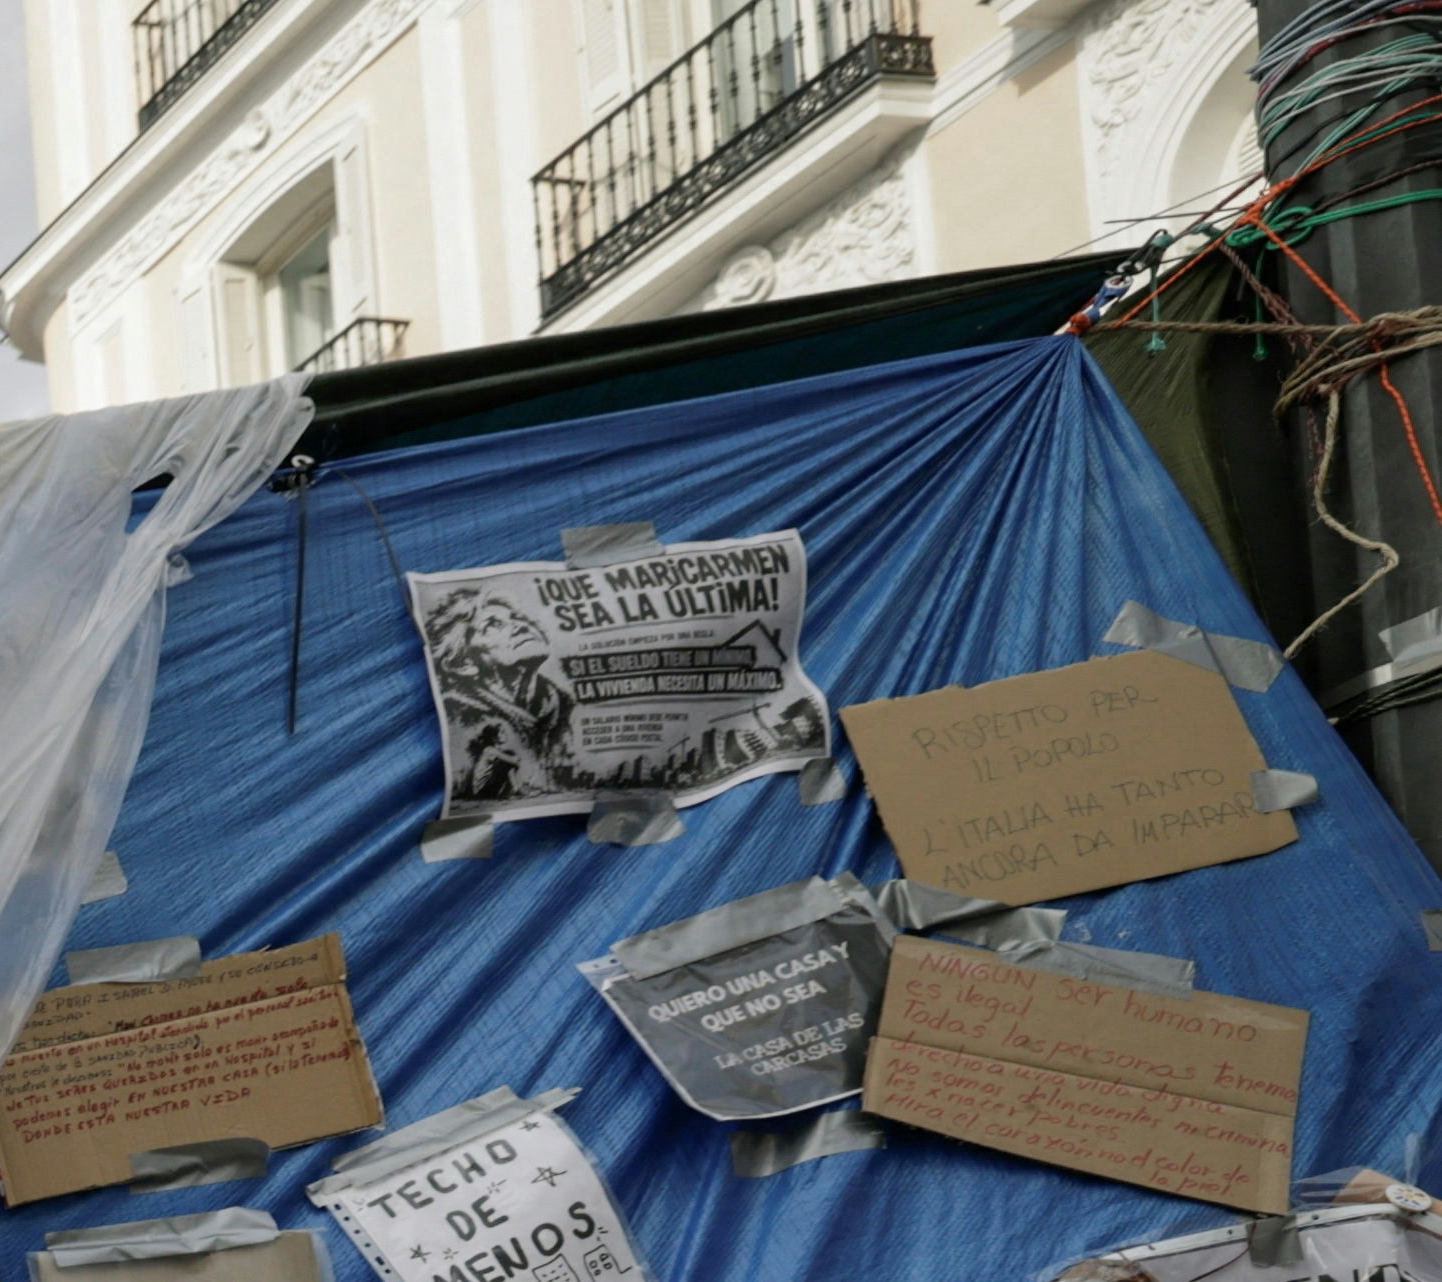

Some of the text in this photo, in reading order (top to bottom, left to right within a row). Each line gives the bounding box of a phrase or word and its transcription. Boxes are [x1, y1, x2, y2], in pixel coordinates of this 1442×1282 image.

[555, 602, 614, 632] SEA
[619, 593, 658, 623] LA
[609, 651, 660, 671] SUELDO
[597, 673, 706, 696] VIVIENDA NECESITA
[911, 702, 1068, 760] RISPETTO
[1014, 732, 1119, 774] POPOLO
[1112, 768, 1225, 804] TANTO
[648, 949, 836, 1022] QUIERO UNA CASA
[701, 979, 827, 1032] QUE NO SEA
[955, 982, 1033, 1020] ilegal
[742, 1012, 864, 1060] CASA DE LAS
[1123, 990, 1258, 1043] humano
[751, 1037, 847, 1076] CARCASAS
[1050, 1042, 1196, 1082] personas
[367, 1137, 518, 1221] TECHO
[445, 1193, 512, 1244] DE
